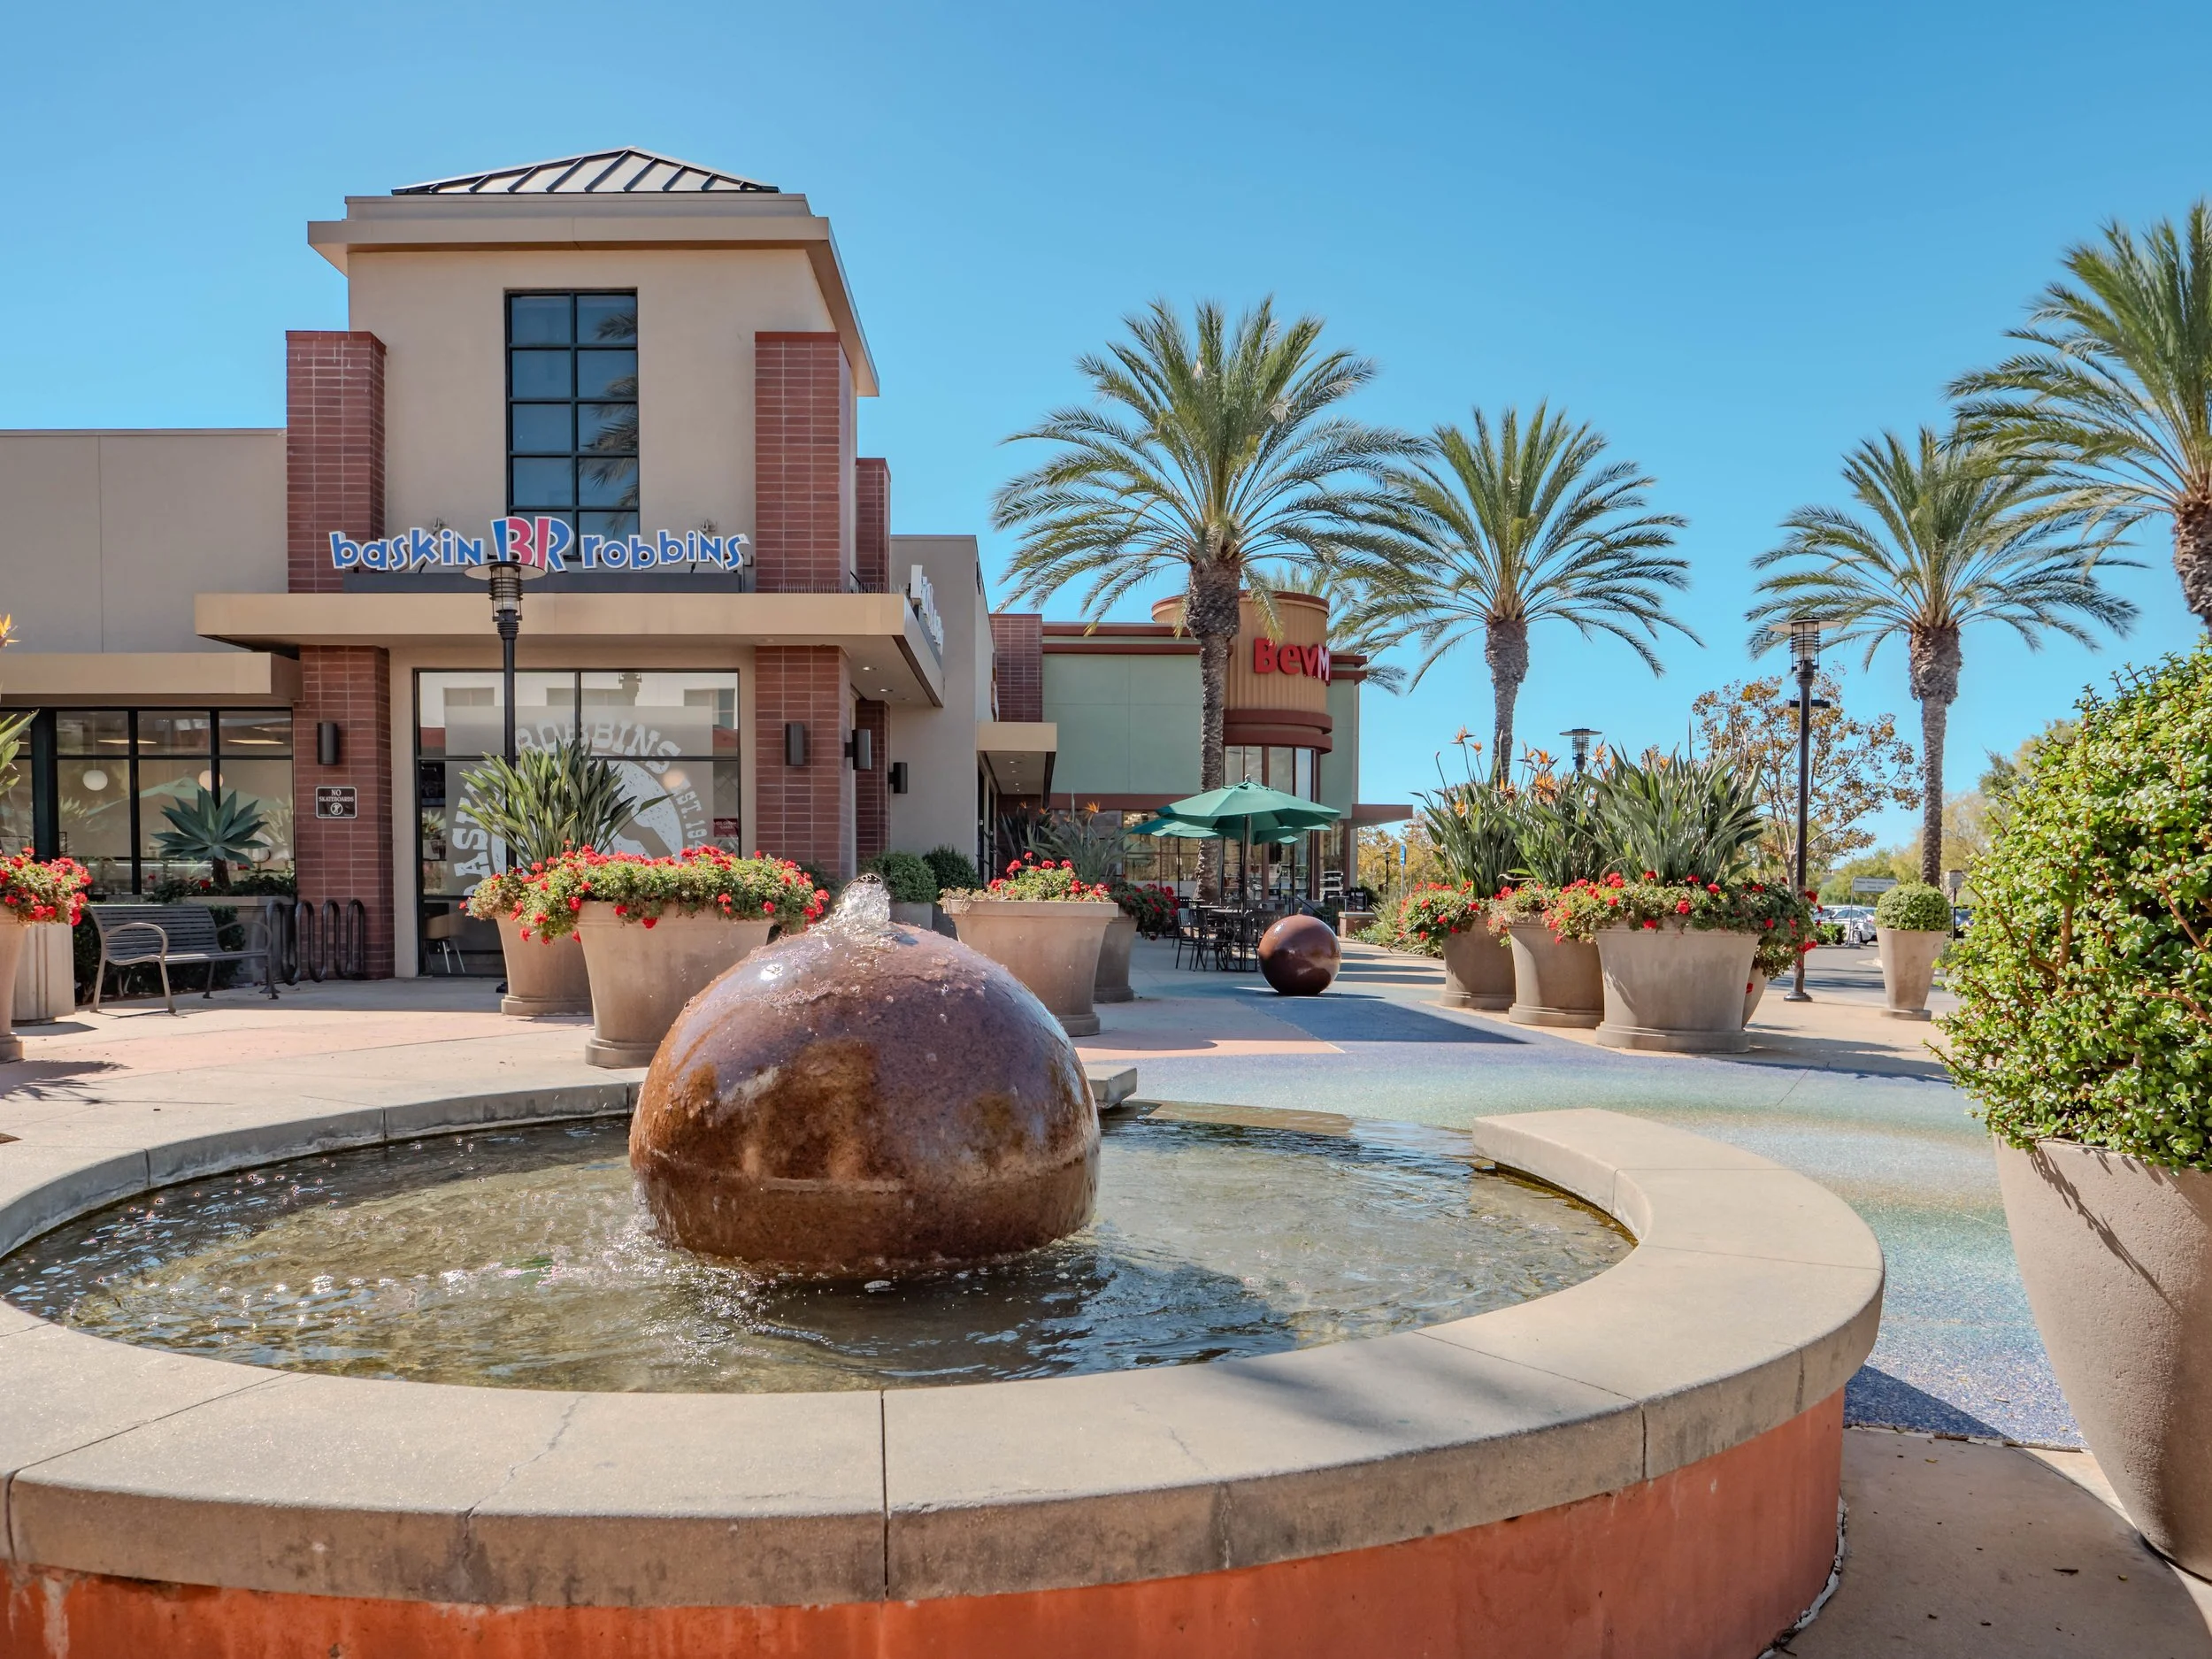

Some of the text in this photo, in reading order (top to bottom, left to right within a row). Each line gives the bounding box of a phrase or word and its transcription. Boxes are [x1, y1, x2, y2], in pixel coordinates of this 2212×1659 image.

[329, 516, 750, 572] baskin BR robbins
[452, 760, 505, 896] ASK
[685, 819, 708, 849] 194
